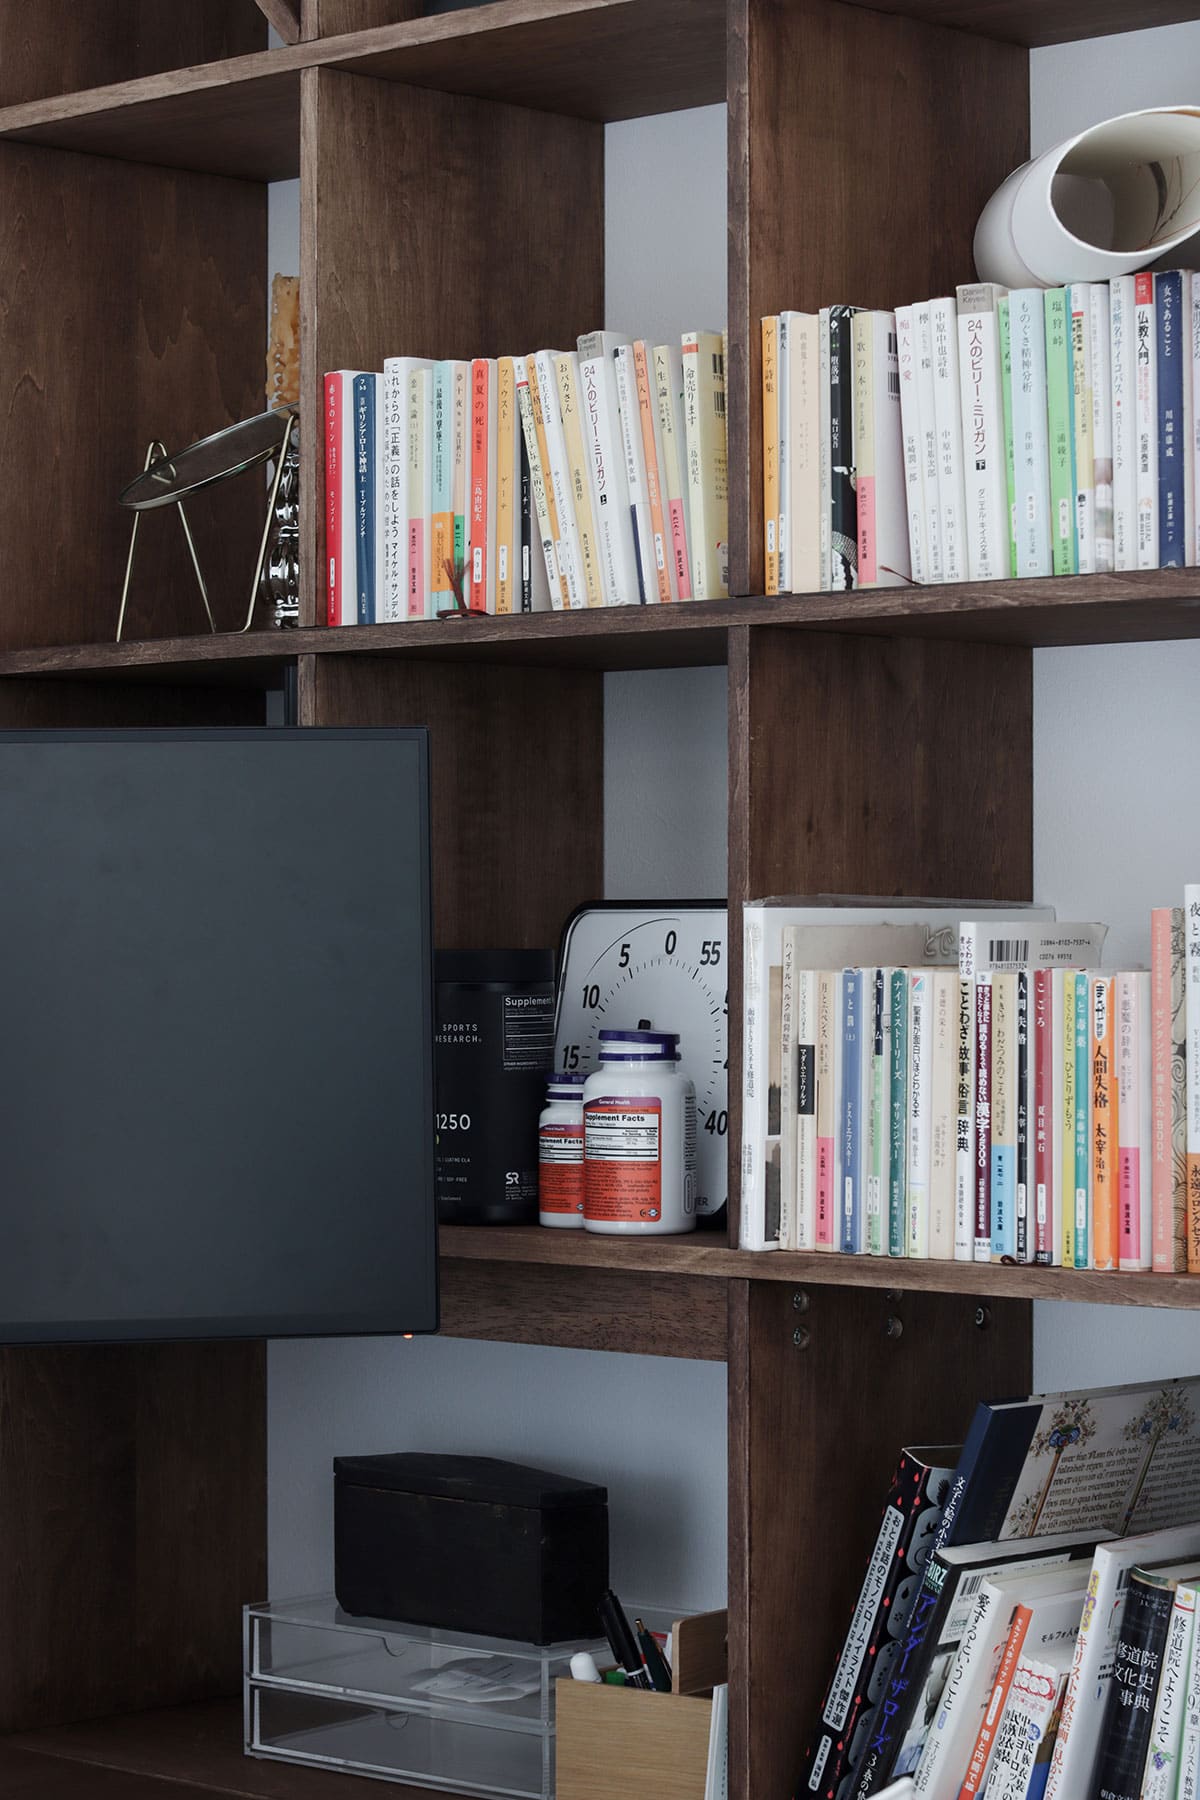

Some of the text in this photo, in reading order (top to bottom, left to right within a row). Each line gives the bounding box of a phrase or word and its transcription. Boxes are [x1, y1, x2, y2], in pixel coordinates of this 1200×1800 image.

[936, 311, 949, 379] 中原中也詩集
[1052, 300, 1064, 347] 塩狩峠
[1138, 310, 1150, 366] 仏教入門
[1163, 284, 1173, 358] 女であること
[765, 328, 774, 393] ゲーテ詩集
[900, 319, 912, 381] 痴人の愛
[1020, 301, 1033, 394] ものぐさ精神分析
[474, 369, 485, 427] 真夏の死
[501, 368, 509, 420] ファウスト
[560, 363, 573, 414] おバカさん
[657, 355, 669, 398] 人生論
[686, 367, 698, 427] 命売ります
[967, 319, 987, 455] 24人のビリー・ミリガン
[583, 365, 606, 491] 24人のビリー・ミリガン
[1056, 421, 1068, 468] 三浦綾子
[690, 441, 701, 485] 三島由紀夫
[941, 431, 953, 476] 中原中也
[390, 363, 402, 619] これからの「正義」の話をしよう マイケル・サンデル
[474, 478, 483, 523] 三島由紀夫
[618, 944, 631, 968] 5
[665, 930, 677, 955] 0
[700, 941, 721, 966] 55
[965, 935, 973, 976] よくわかる
[582, 985, 600, 1009] 10
[783, 943, 793, 1055] ハイデルベルク信仰問答
[821, 982, 829, 1039] 月と六ペンス
[875, 979, 884, 1041] モーム
[1018, 980, 1027, 1046] 人間失格
[1037, 982, 1046, 1028] こころ
[442, 1024, 478, 1032] SPORTS
[893, 979, 903, 1081] ナイン・ストーリーズ
[563, 1045, 580, 1070] 15
[1094, 1045, 1109, 1108] 人間失格
[436, 1113, 471, 1130] 1250
[622, 1114, 645, 1122] Facts
[704, 1110, 728, 1135] 40
[893, 1101, 901, 1160] サリンジャー
[957, 1118, 970, 1153] 辞典
[976, 1101, 990, 1168] 漢字2500
[1037, 1104, 1047, 1154] 夏目漱石
[1156, 1124, 1164, 1163] BOOK
[882, 1509, 893, 1537] FAIRY
[871, 1593, 938, 1755] アンダーザローズ
[943, 1592, 990, 1711] 愛するということ
[1117, 1639, 1159, 1671] 修道院
[1111, 1662, 1155, 1692] 文化史
[1119, 1688, 1150, 1713] 事典
[1156, 1614, 1187, 1743] 修道院へようこそ
[868, 1754, 878, 1766] 3
